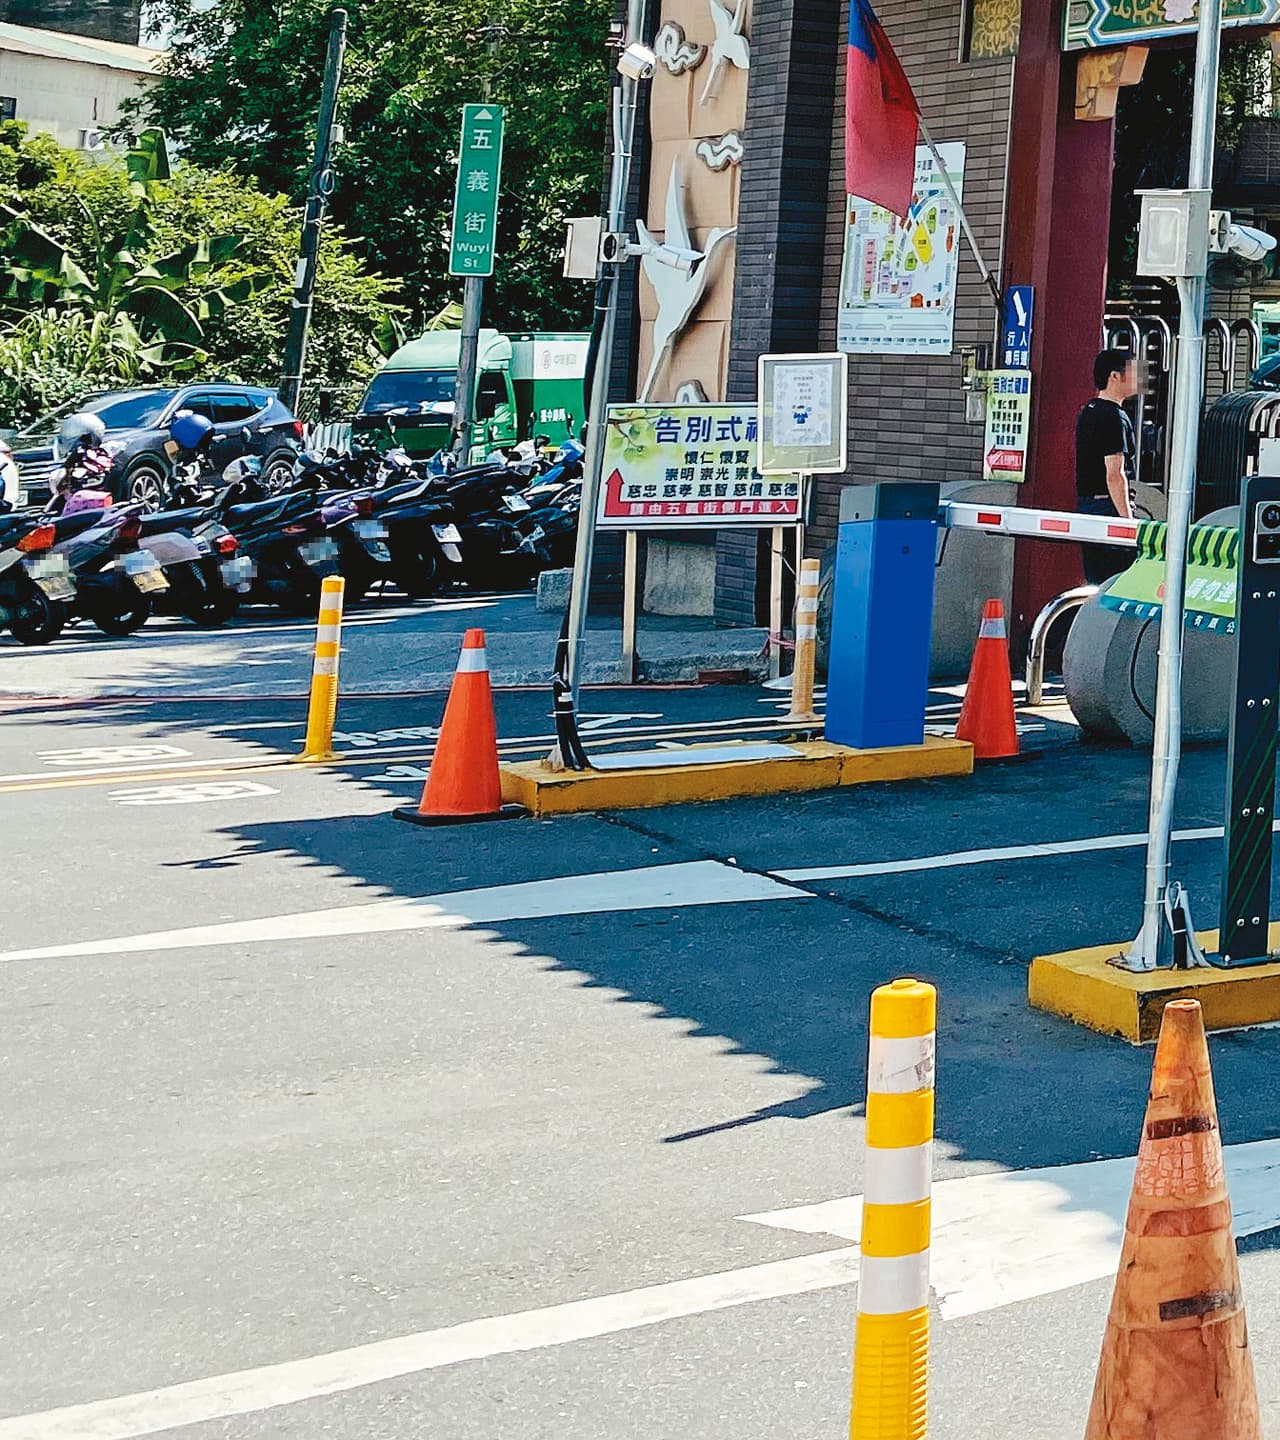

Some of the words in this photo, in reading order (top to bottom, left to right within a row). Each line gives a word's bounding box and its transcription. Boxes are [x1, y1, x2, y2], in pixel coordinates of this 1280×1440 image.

[463, 129, 493, 233] 五義街
[456, 243, 489, 253] Wuyi
[1007, 331, 1028, 347] 行人
[684, 451, 714, 464] 懷仁
[665, 468, 695, 481] 崇明
[700, 468, 729, 481] 崇光
[1185, 577, 1236, 604] 請勿進
